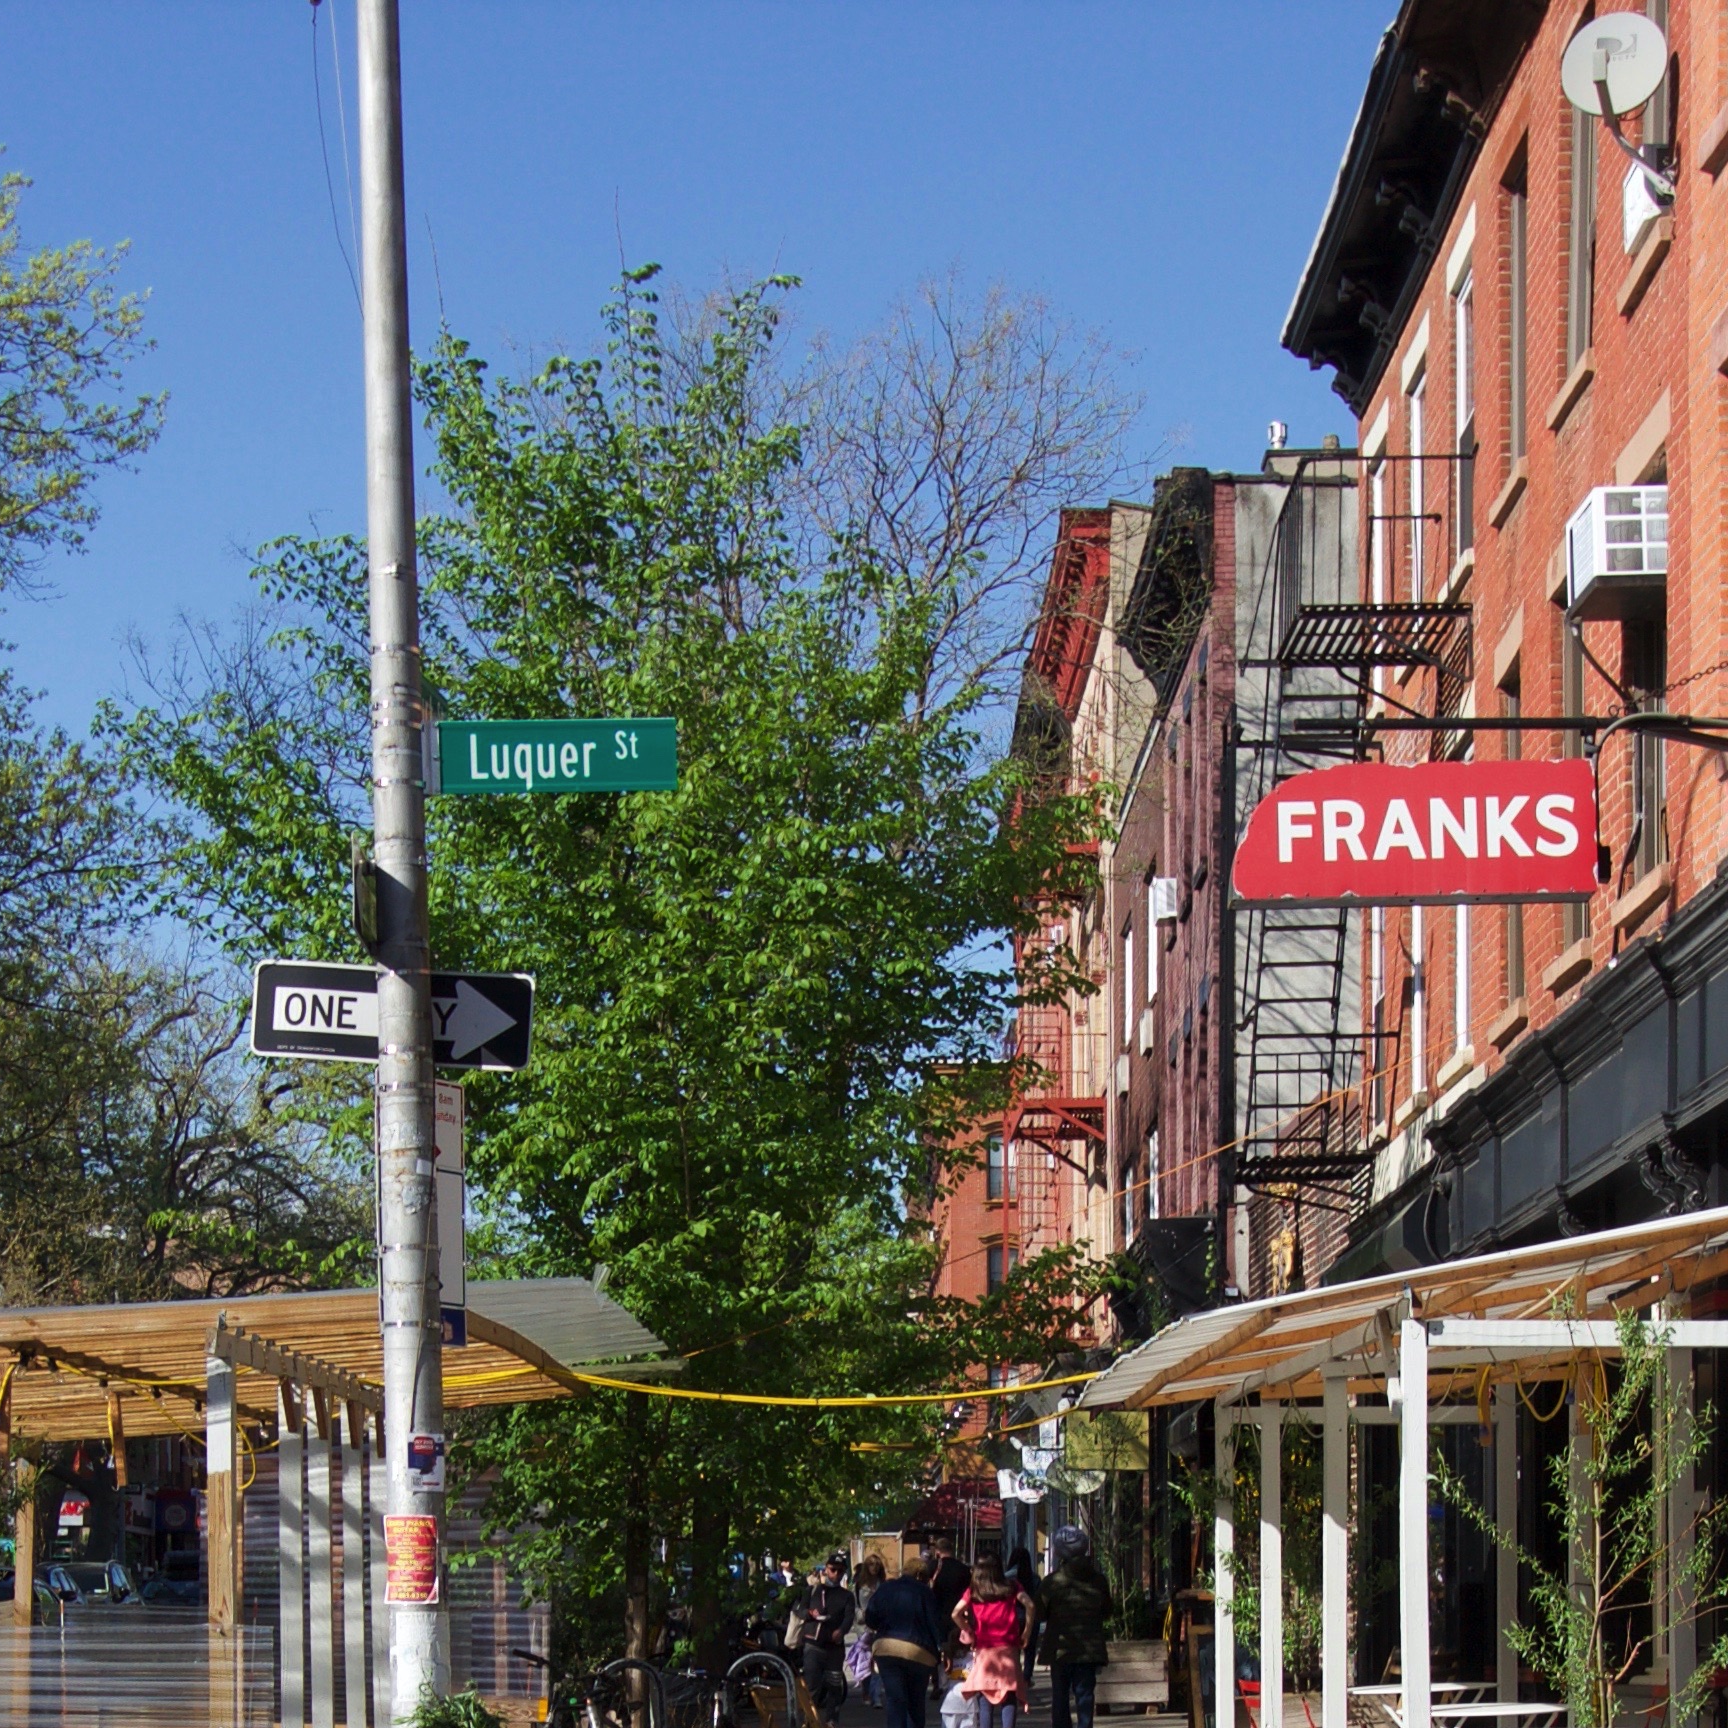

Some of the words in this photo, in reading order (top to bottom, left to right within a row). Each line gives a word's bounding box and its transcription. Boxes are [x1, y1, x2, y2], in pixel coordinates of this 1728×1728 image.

[469, 733, 597, 790] Luquer
[614, 731, 639, 760] St
[1276, 793, 1579, 864] FRANKS
[284, 992, 358, 1030] ONE
